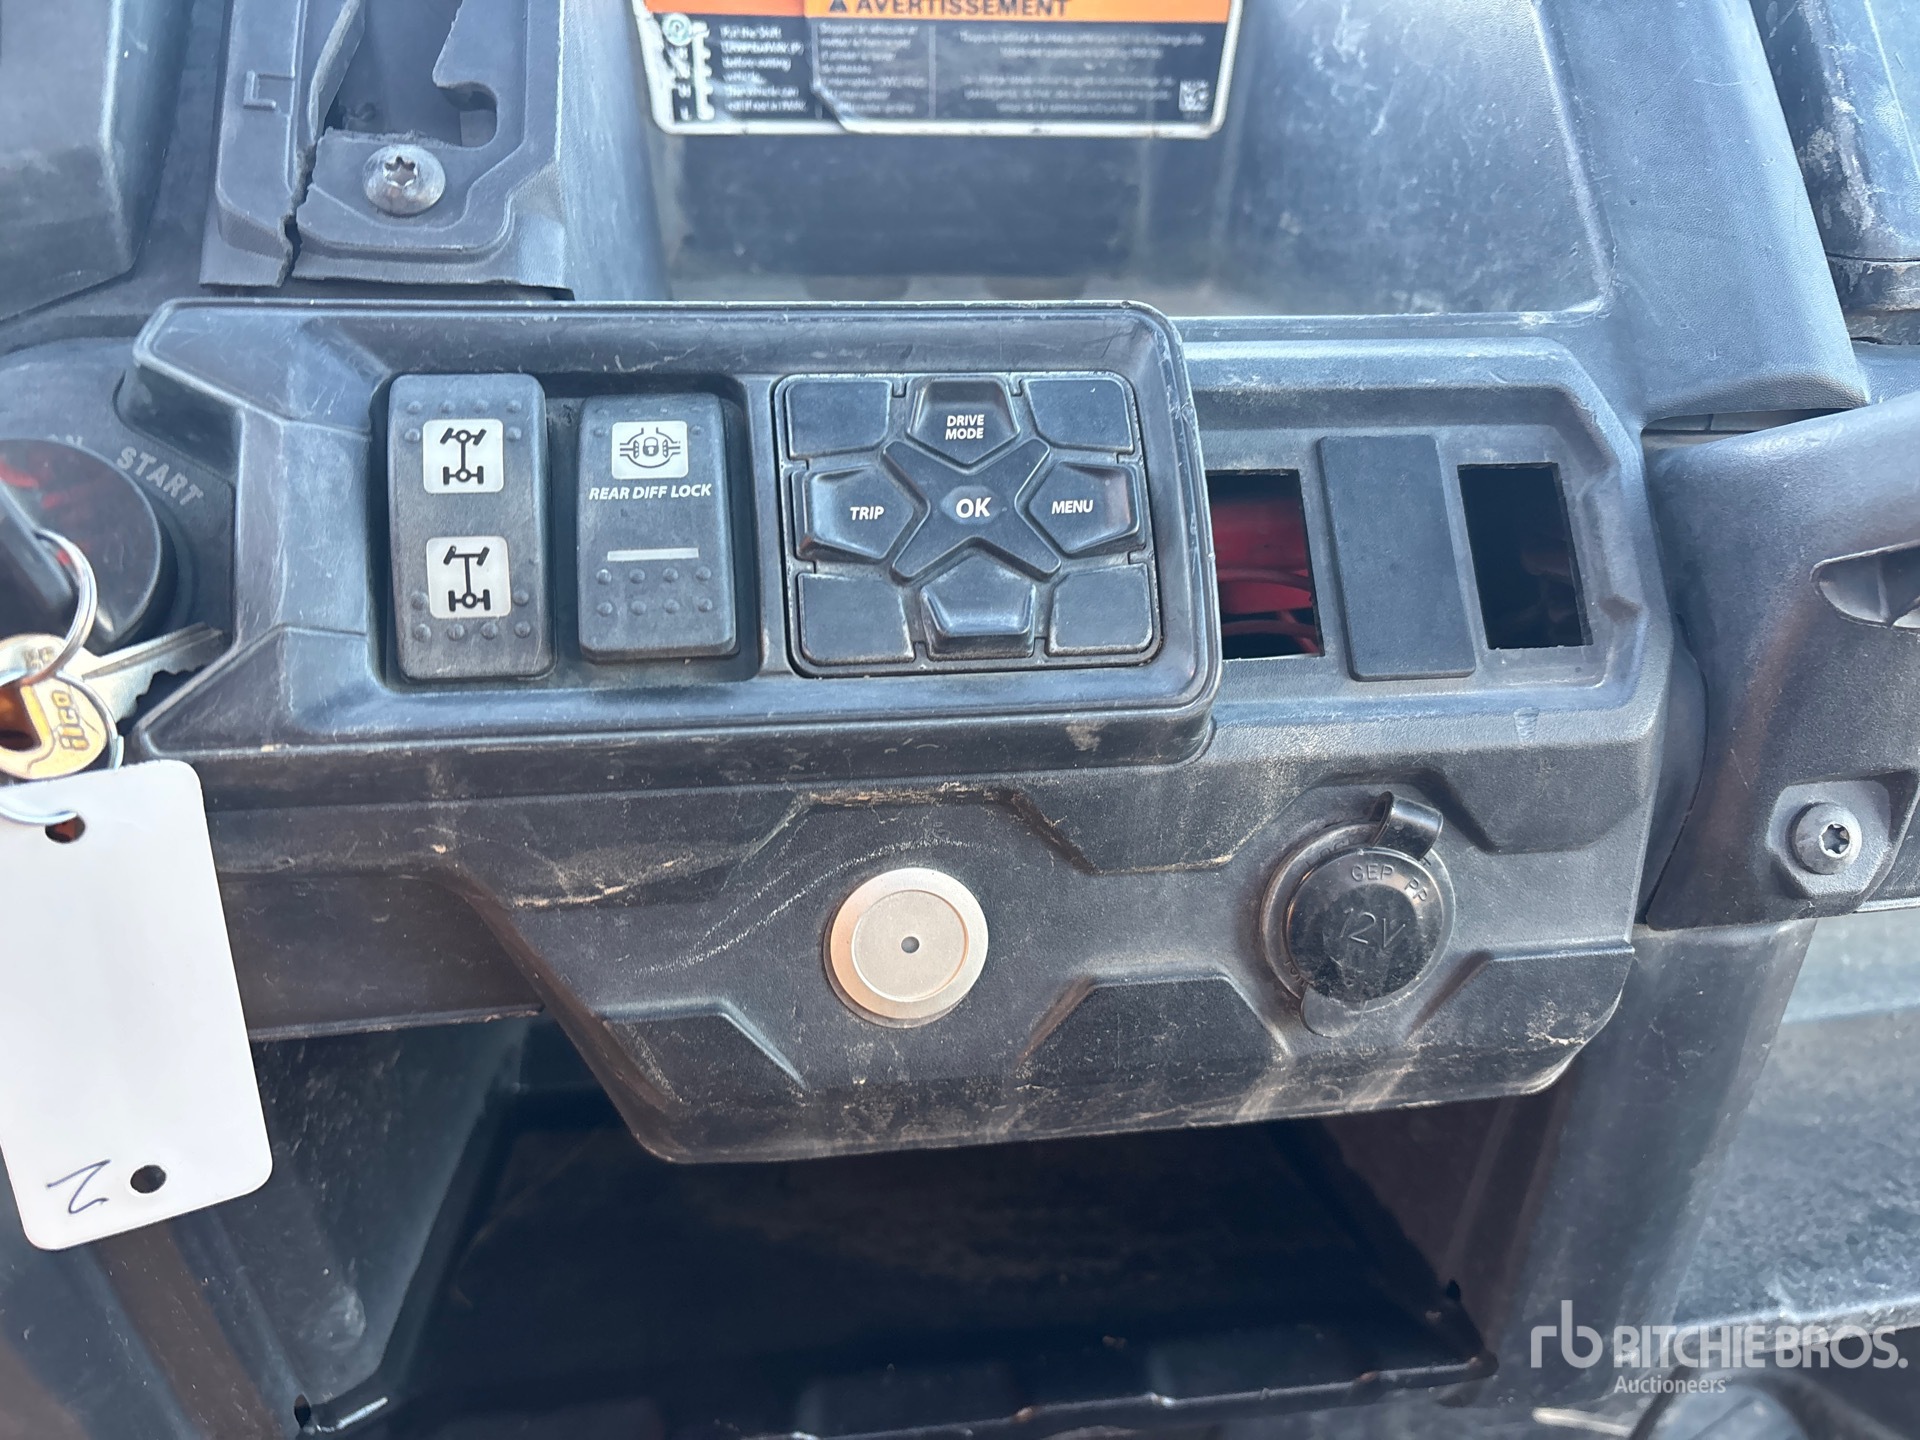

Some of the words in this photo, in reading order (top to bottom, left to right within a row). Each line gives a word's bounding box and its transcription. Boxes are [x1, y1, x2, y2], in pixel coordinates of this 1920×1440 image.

[855, 0, 1070, 16] AVERTISSEMENT
[946, 414, 985, 427] DRIVE
[944, 427, 984, 440] MODE
[116, 446, 205, 506] START
[588, 486, 631, 501] REAR
[632, 485, 668, 500] DIFF
[670, 483, 713, 498] LOCK
[849, 505, 885, 521] TRIP
[955, 496, 992, 519] OK
[1051, 499, 1094, 515] MENU
[1350, 863, 1395, 883] GEP
